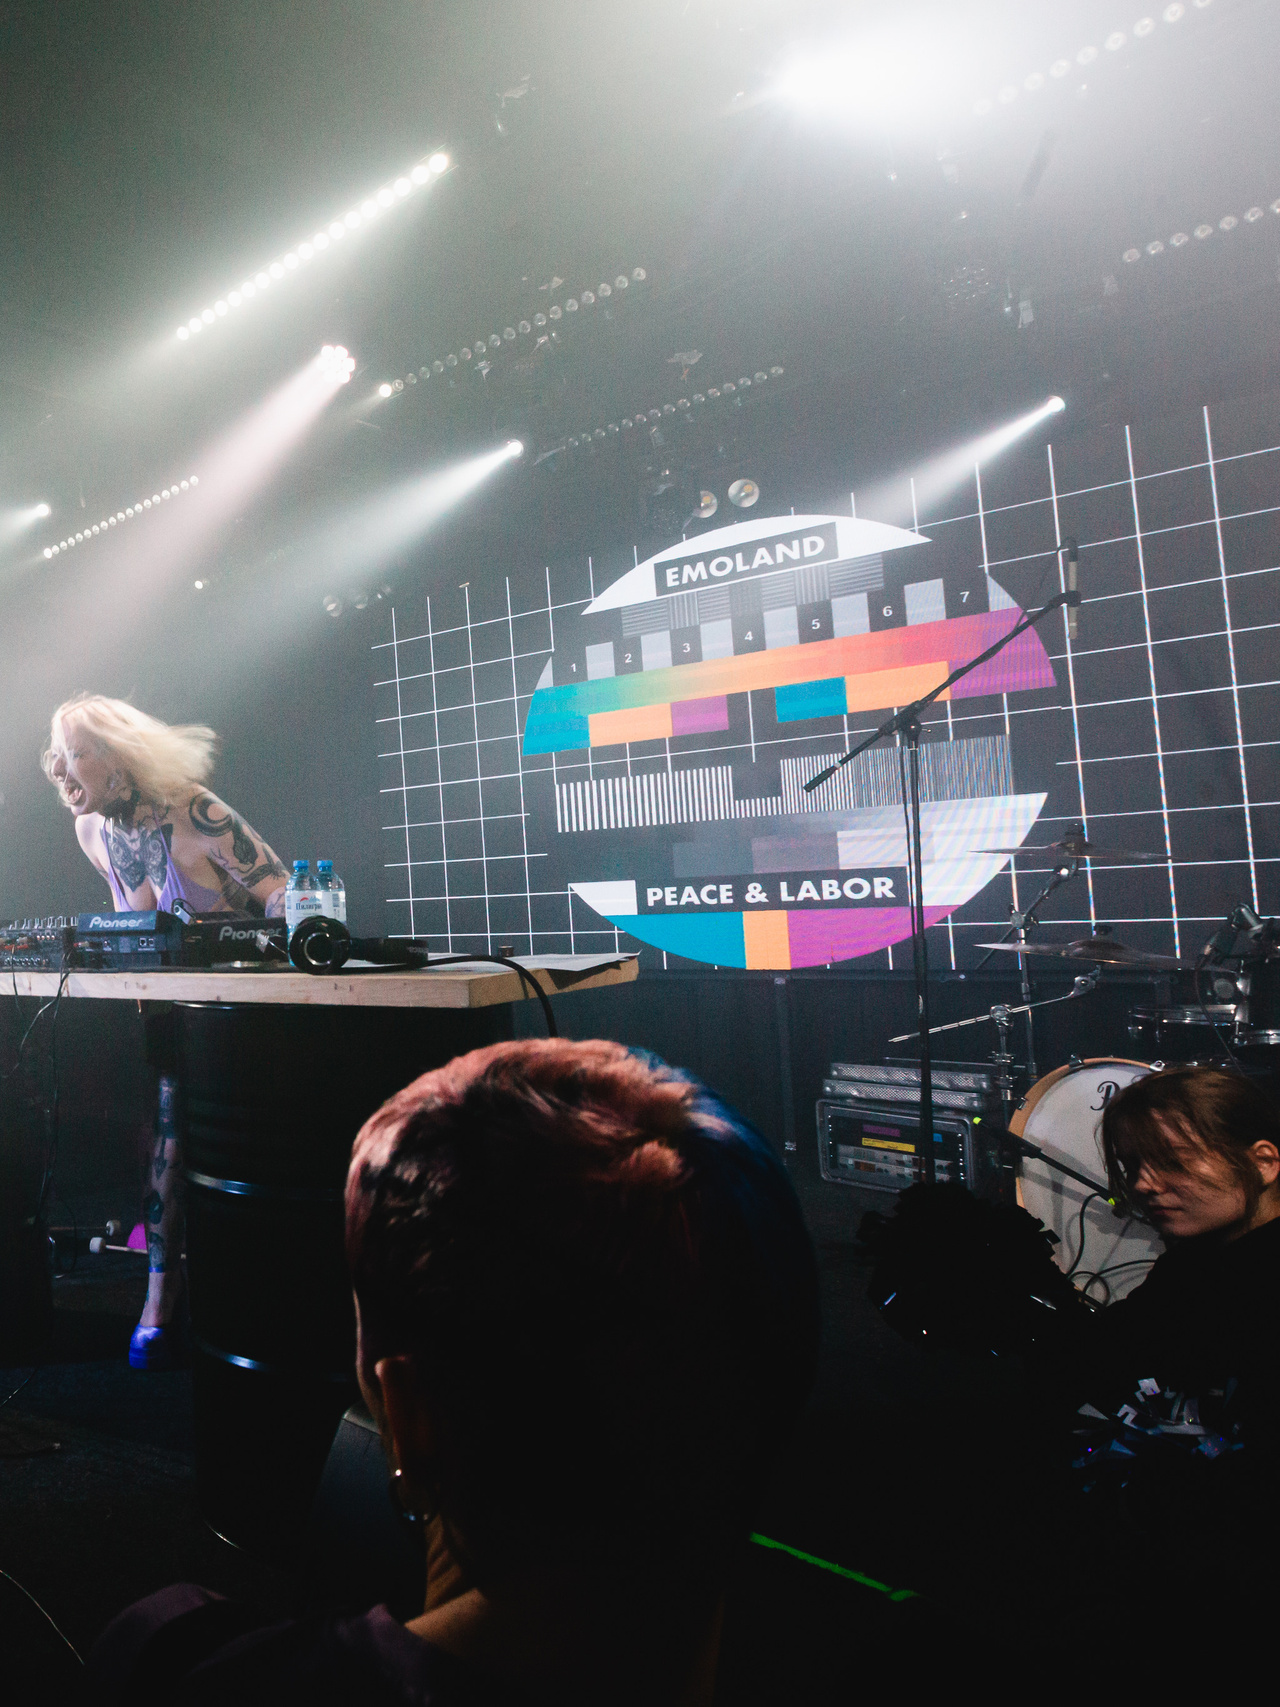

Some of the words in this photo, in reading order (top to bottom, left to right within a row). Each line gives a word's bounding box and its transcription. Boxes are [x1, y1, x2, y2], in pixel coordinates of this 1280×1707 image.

[666, 536, 825, 587] EMOLAND
[570, 663, 577, 673] 1
[624, 653, 632, 664] 2
[683, 642, 691, 653] 3
[744, 631, 753, 642] 4
[811, 618, 821, 630] 5
[882, 605, 893, 617] 6
[959, 591, 970, 603] 7
[646, 884, 734, 907] PEACE
[744, 882, 769, 904] &
[779, 876, 896, 902] LABOR
[89, 915, 143, 929] Pioneer
